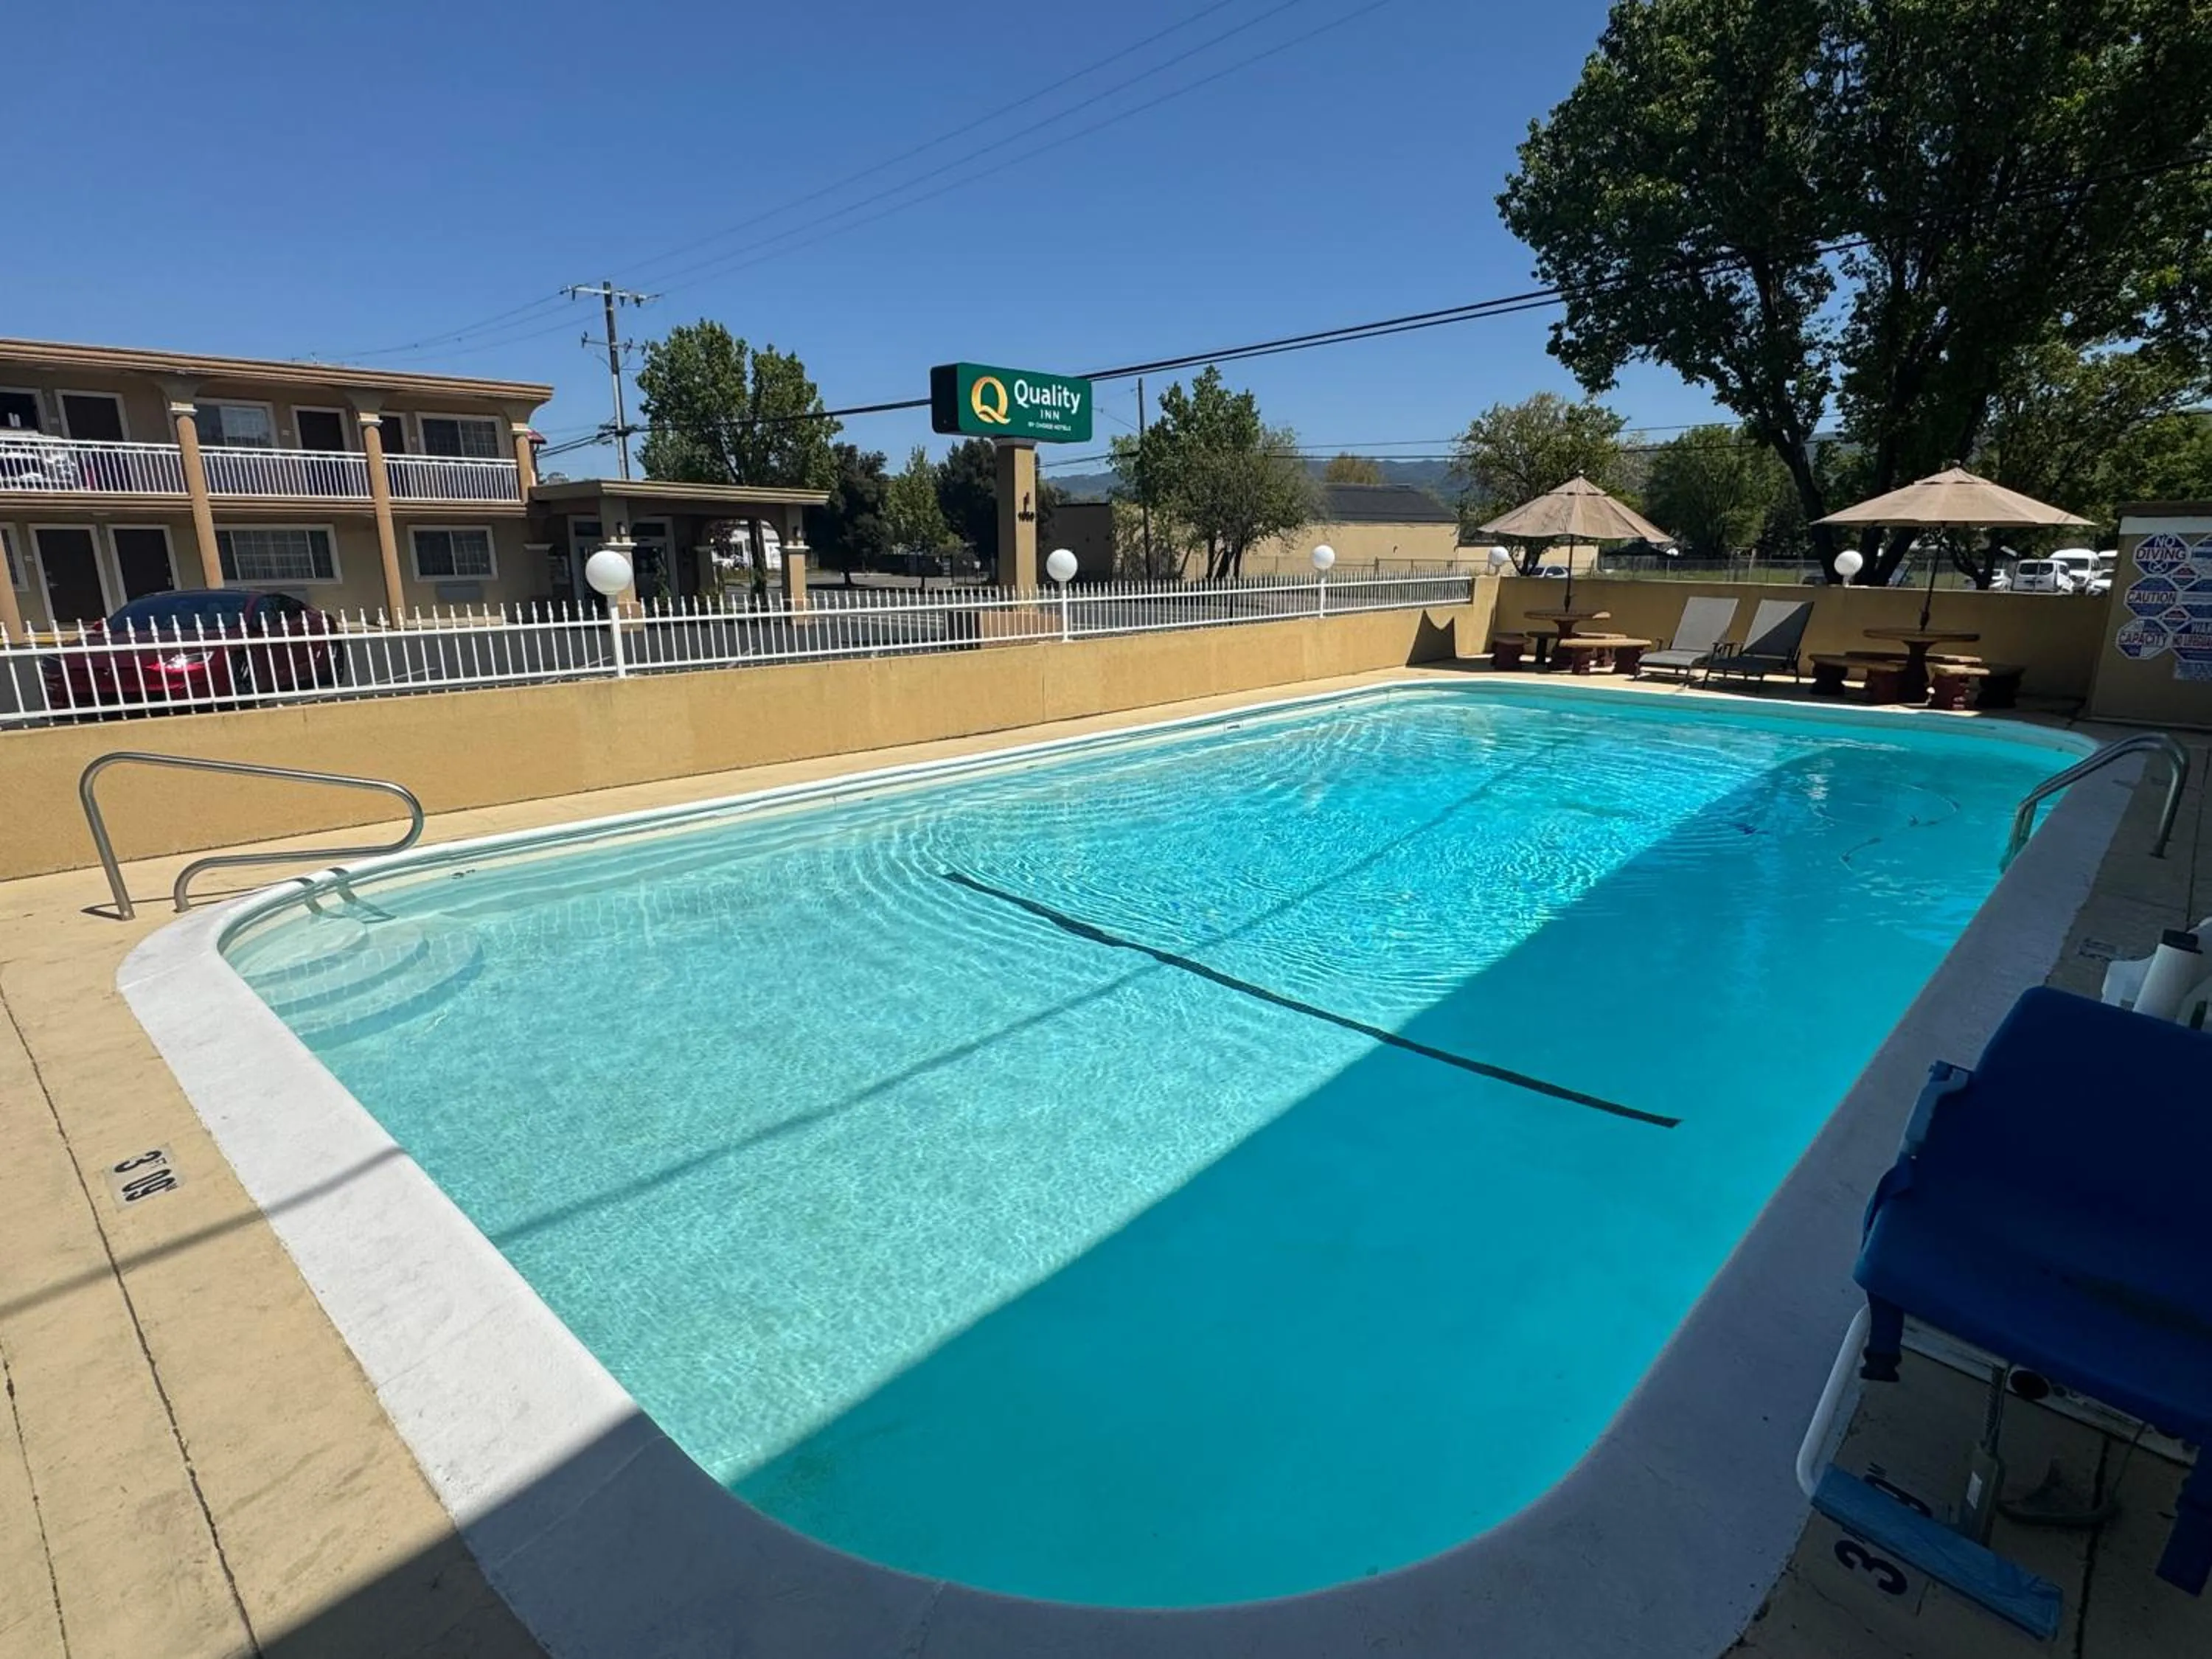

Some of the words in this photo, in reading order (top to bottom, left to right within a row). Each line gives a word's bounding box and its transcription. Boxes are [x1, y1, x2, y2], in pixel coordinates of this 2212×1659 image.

[971, 377, 1010, 424] Q
[1014, 379, 1081, 414] Quality
[1040, 409, 1060, 420] INN
[2154, 536, 2175, 549] NO
[2136, 548, 2186, 560] DIVING
[2127, 591, 2176, 602] CAUTION
[2118, 632, 2168, 646] CAPACITY
[1833, 1539, 1907, 1596] 3
